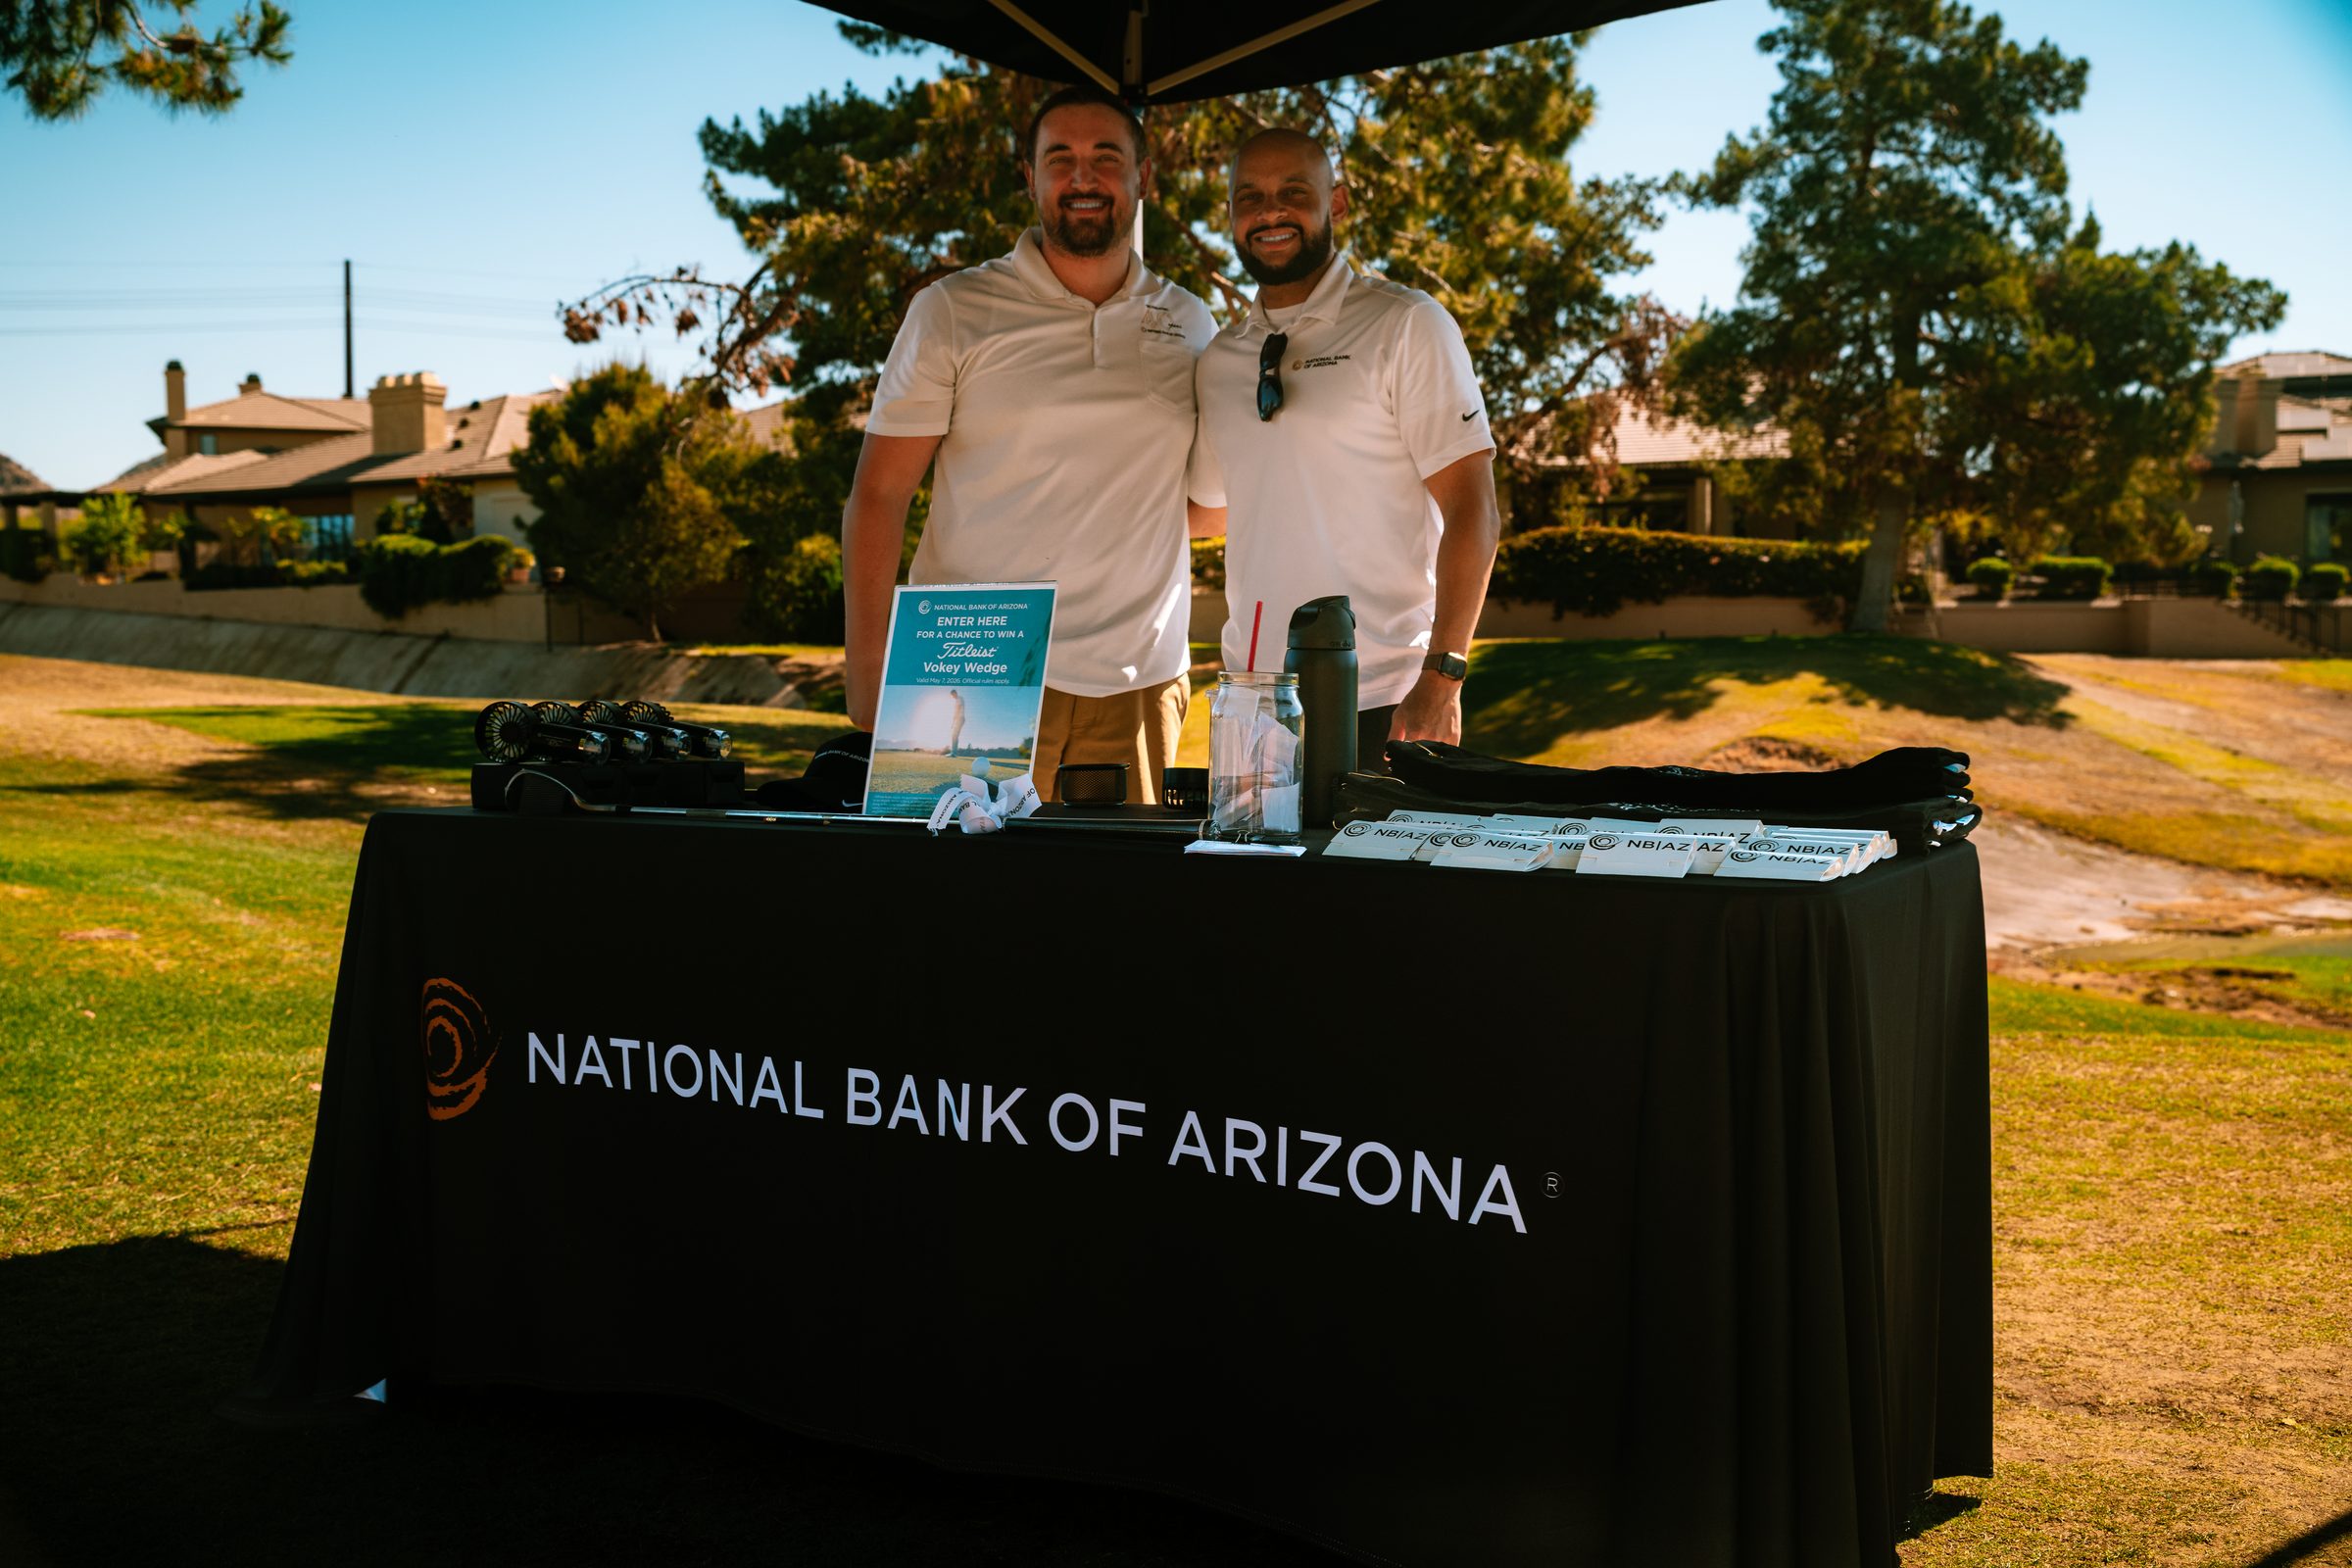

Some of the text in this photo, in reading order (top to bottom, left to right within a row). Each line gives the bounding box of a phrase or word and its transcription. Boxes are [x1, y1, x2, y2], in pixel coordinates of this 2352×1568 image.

[937, 616, 1007, 626] ENTER HERE
[937, 642, 998, 659] Titleist
[923, 662, 1007, 675] Vokey Wedge
[528, 1032, 823, 1118] NATIONAL
[847, 1068, 1028, 1145] BANK
[1049, 1093, 1146, 1155] OF
[1168, 1110, 1527, 1233] ARIZONA
